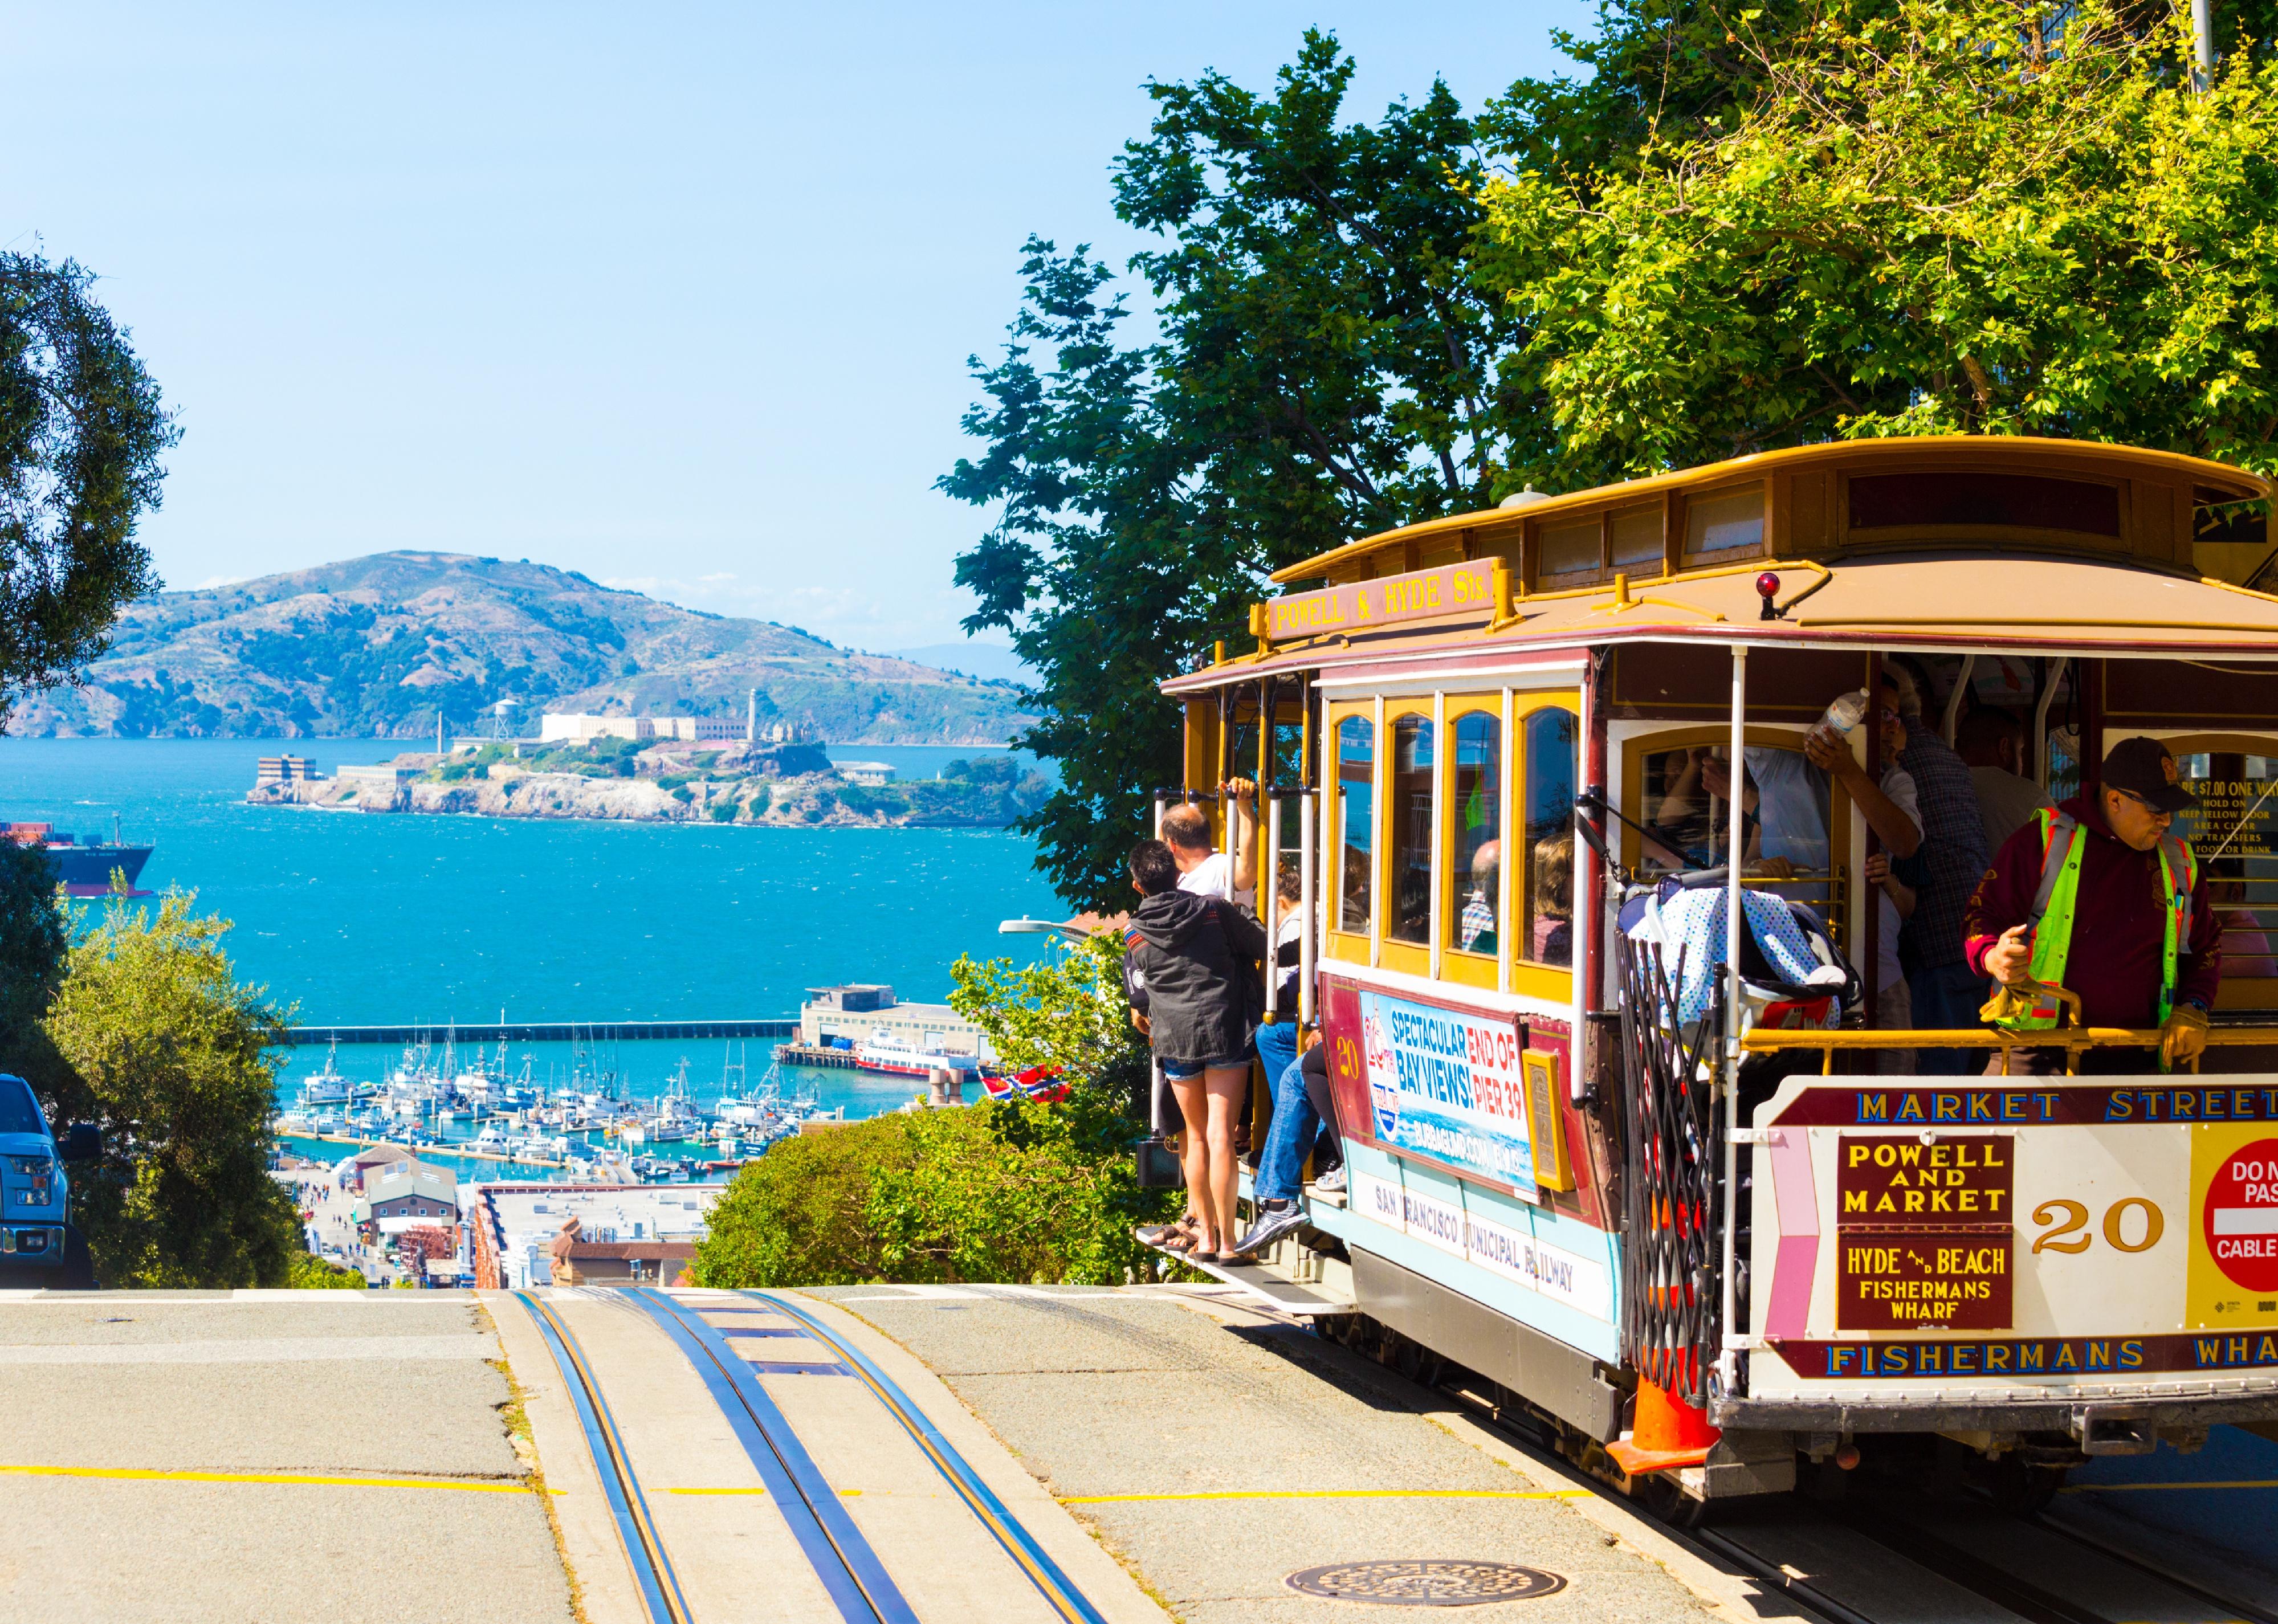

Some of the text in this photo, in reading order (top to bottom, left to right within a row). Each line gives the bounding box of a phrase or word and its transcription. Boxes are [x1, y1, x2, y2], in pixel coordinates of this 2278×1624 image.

[1277, 570, 1488, 631] POWELL & HYDE Sts.
[2181, 781, 2196, 796] RE
[2199, 781, 2226, 797] $7.00
[2228, 782, 2252, 797] ONE
[2203, 799, 2246, 807] HOLD ON
[2203, 810, 2239, 819] YELLOW
[2187, 833, 2202, 842] NO
[2242, 845, 2271, 854] DRINK
[1392, 1010, 1467, 1059] SPECTACULAR
[1337, 1037, 1359, 1079] 20
[1467, 1027, 1515, 1072] END OF
[1396, 1049, 1421, 1095] BAY
[1422, 1056, 1474, 1110] VIEWS!
[1473, 1074, 1505, 1117] PIER
[1505, 1080, 1522, 1120] 39
[1856, 1088, 2278, 1123] MARKET STREET
[1413, 1120, 1490, 1168] BUBBAGUMP.COM
[1849, 1144, 2004, 1168] POWELL
[1889, 1169, 1966, 1186] AND
[2232, 1161, 2264, 1181] DO
[1375, 1185, 1397, 1217] SAN
[1844, 1189, 2006, 1213] MARKET
[2245, 1182, 2278, 1203] PAS
[2032, 1197, 2164, 1254] 20
[2217, 1239, 2277, 1258] CABLE
[1848, 1248, 2005, 1274] HYDE AND BEACH
[1860, 1281, 1991, 1299] FISHERMANS
[1891, 1301, 1959, 1320] WHARF
[1826, 1336, 2278, 1376] FISHERMANS WHA
